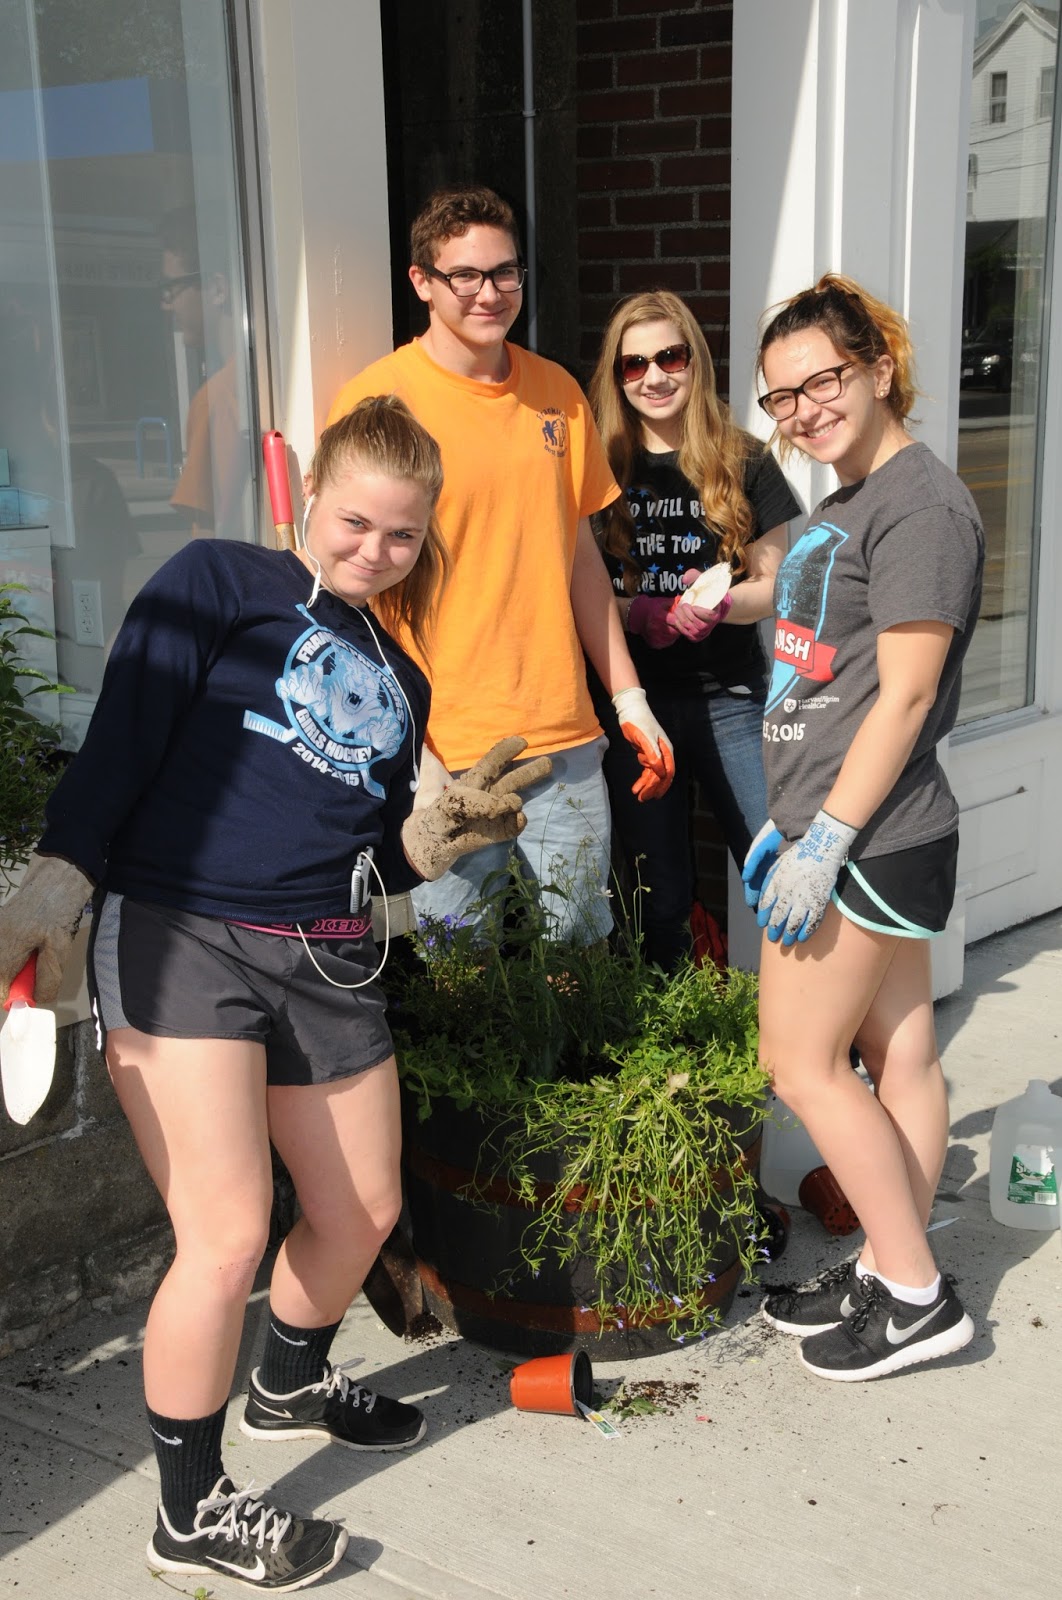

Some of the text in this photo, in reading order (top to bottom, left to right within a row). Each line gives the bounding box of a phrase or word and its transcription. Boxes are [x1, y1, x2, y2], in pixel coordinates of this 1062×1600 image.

[636, 533, 701, 556] THE TOP
[295, 708, 372, 764] GIRLS HOCKEY
[292, 742, 360, 787] 2014-2015
